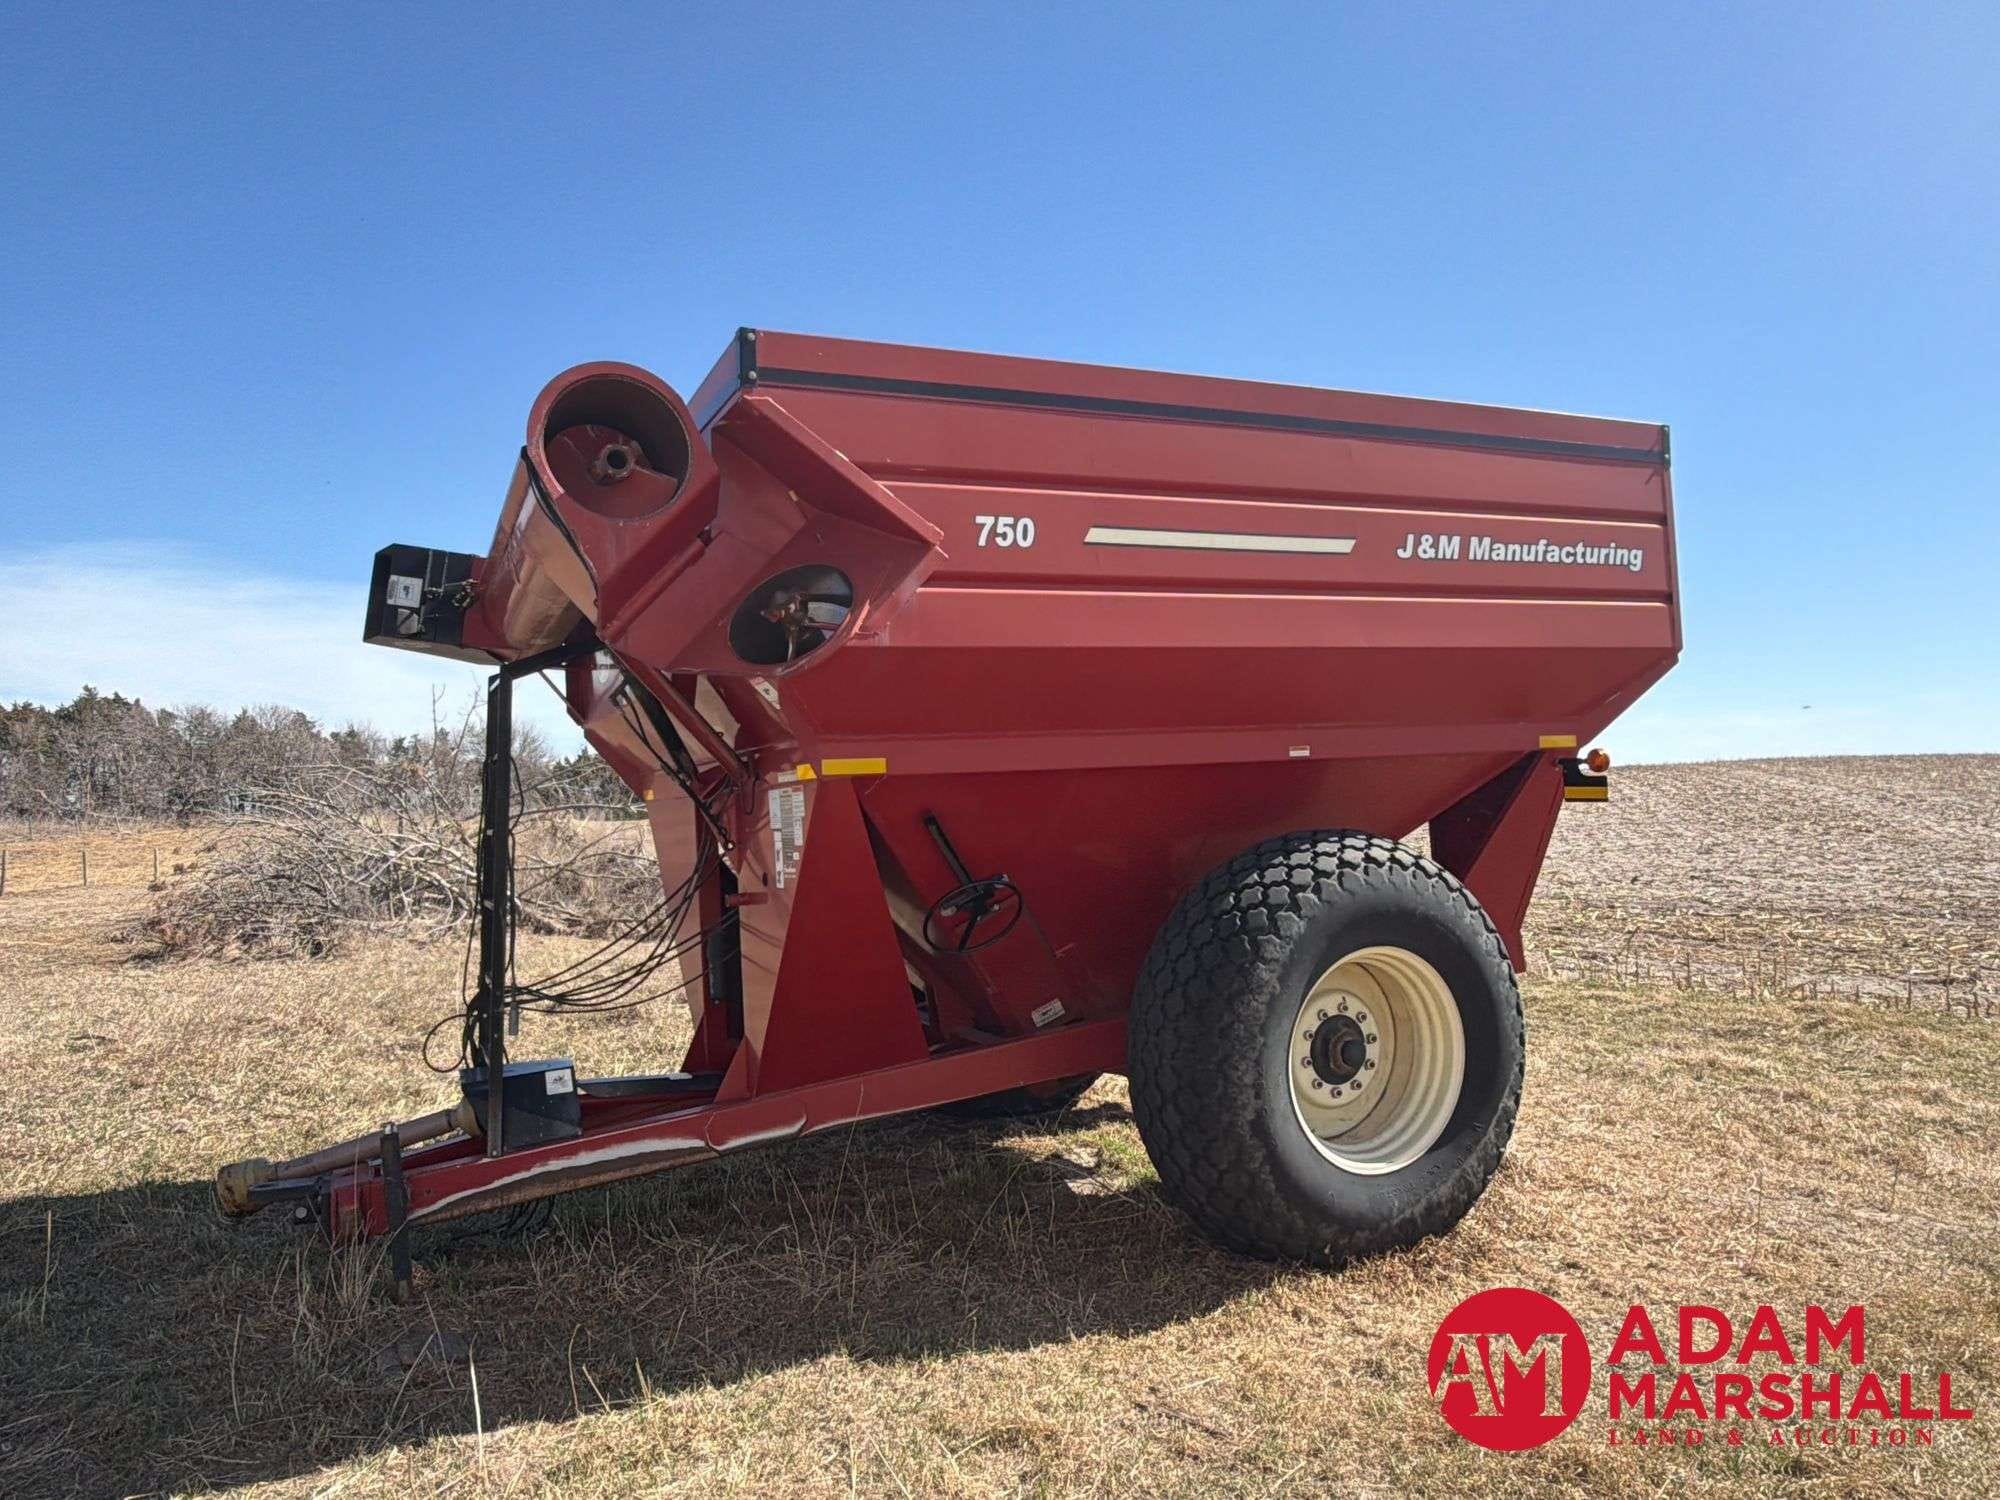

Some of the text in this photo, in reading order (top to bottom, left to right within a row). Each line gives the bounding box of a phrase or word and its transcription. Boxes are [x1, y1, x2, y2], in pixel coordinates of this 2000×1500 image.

[974, 515, 1036, 549] 750
[1396, 534, 1643, 572] J&M Manufacturing
